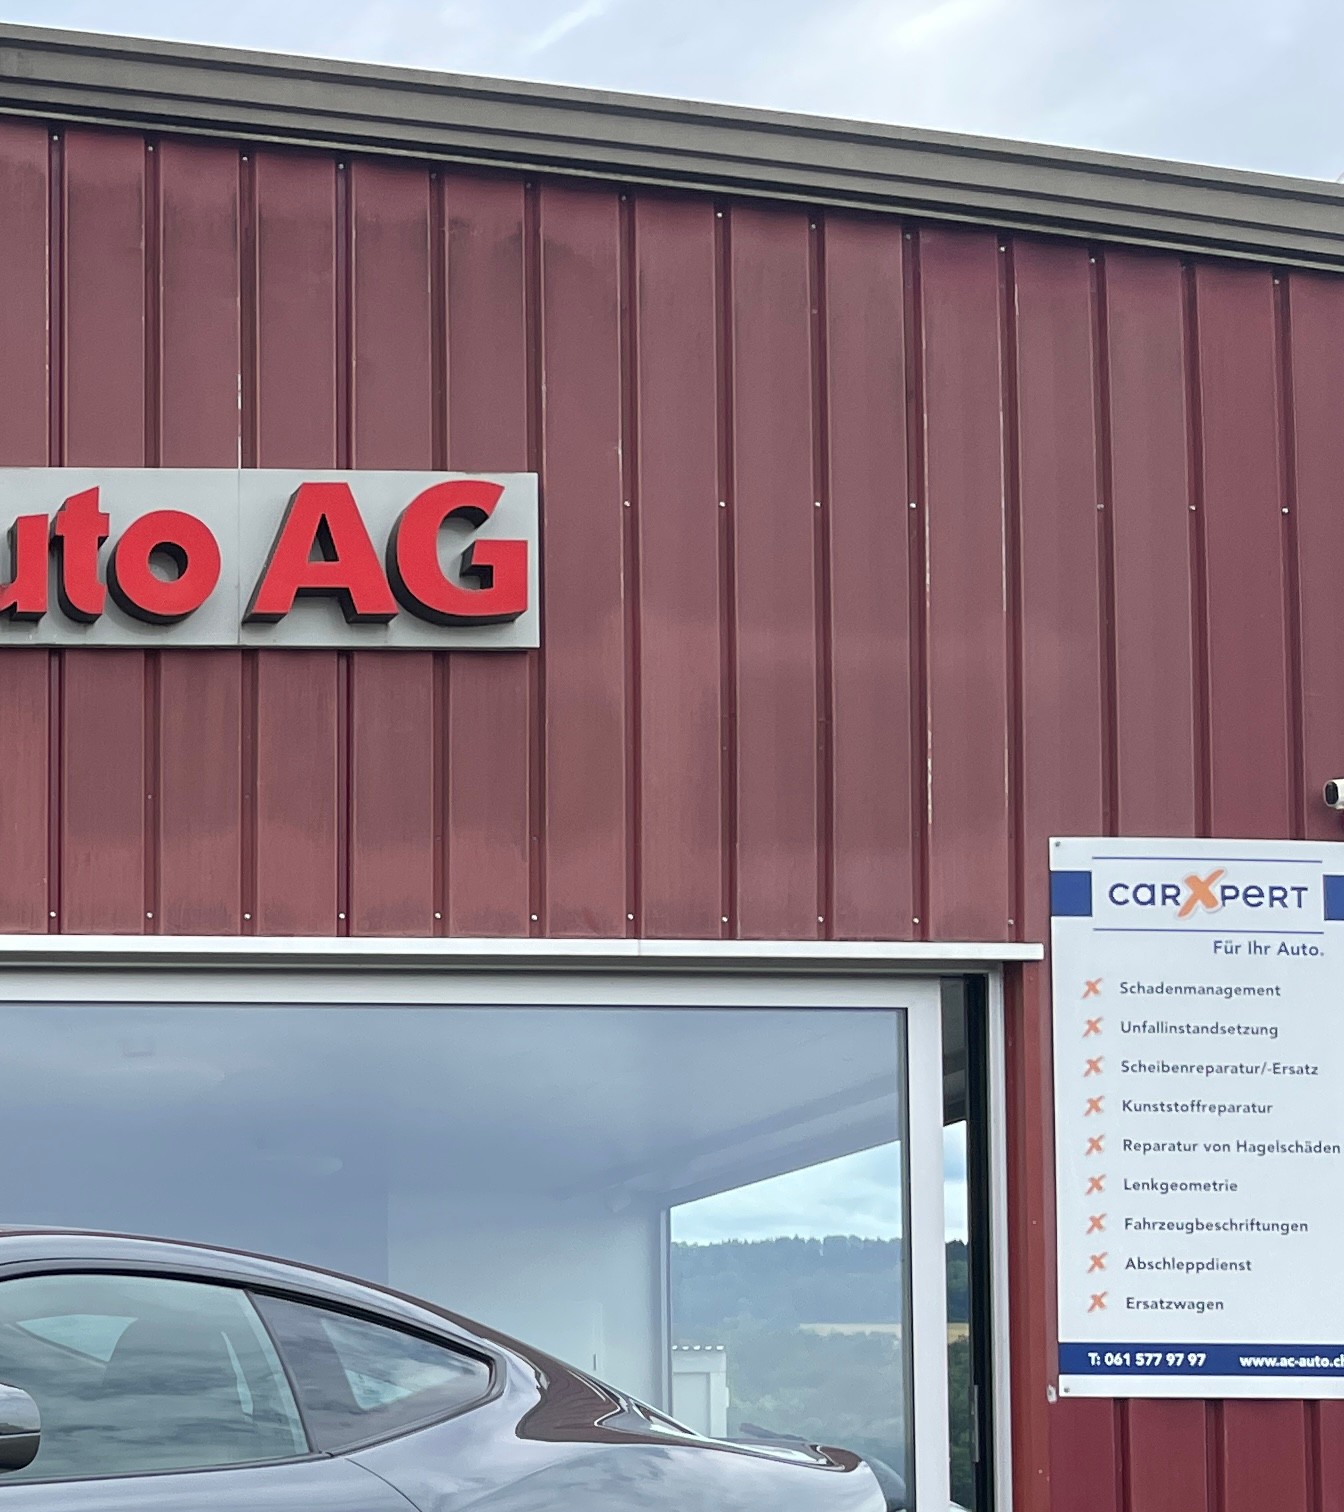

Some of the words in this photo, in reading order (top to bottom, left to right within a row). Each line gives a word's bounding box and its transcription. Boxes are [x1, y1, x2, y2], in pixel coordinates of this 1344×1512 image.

[242, 480, 529, 627] AG
[1213, 939, 1242, 956] Für
[1247, 940, 1272, 956] Ihr
[1276, 941, 1325, 957] Auto.
[1119, 981, 1282, 999] Schadenmanagement
[1120, 1021, 1279, 1039] Unfallinstandsetzung
[1120, 1060, 1319, 1077] Scheibenreparatur/-Ersatz
[1122, 1099, 1274, 1116] Kunststoffreparatur
[1122, 1139, 1198, 1155] Reparatur
[1204, 1142, 1231, 1153] von
[1236, 1140, 1341, 1156] Hagelschäden
[1123, 1178, 1239, 1194] Lenkgeometrie
[1124, 1217, 1309, 1235] Fahrzeugbeschriftungen
[1125, 1257, 1252, 1273] Abschleppdienst
[1126, 1296, 1225, 1314] Ersatzwagen
[1087, 1352, 1101, 1366] T:
[1104, 1352, 1131, 1367] 061
[1135, 1352, 1163, 1367] 577
[1165, 1353, 1185, 1367] 97
[1187, 1353, 1207, 1367] 97
